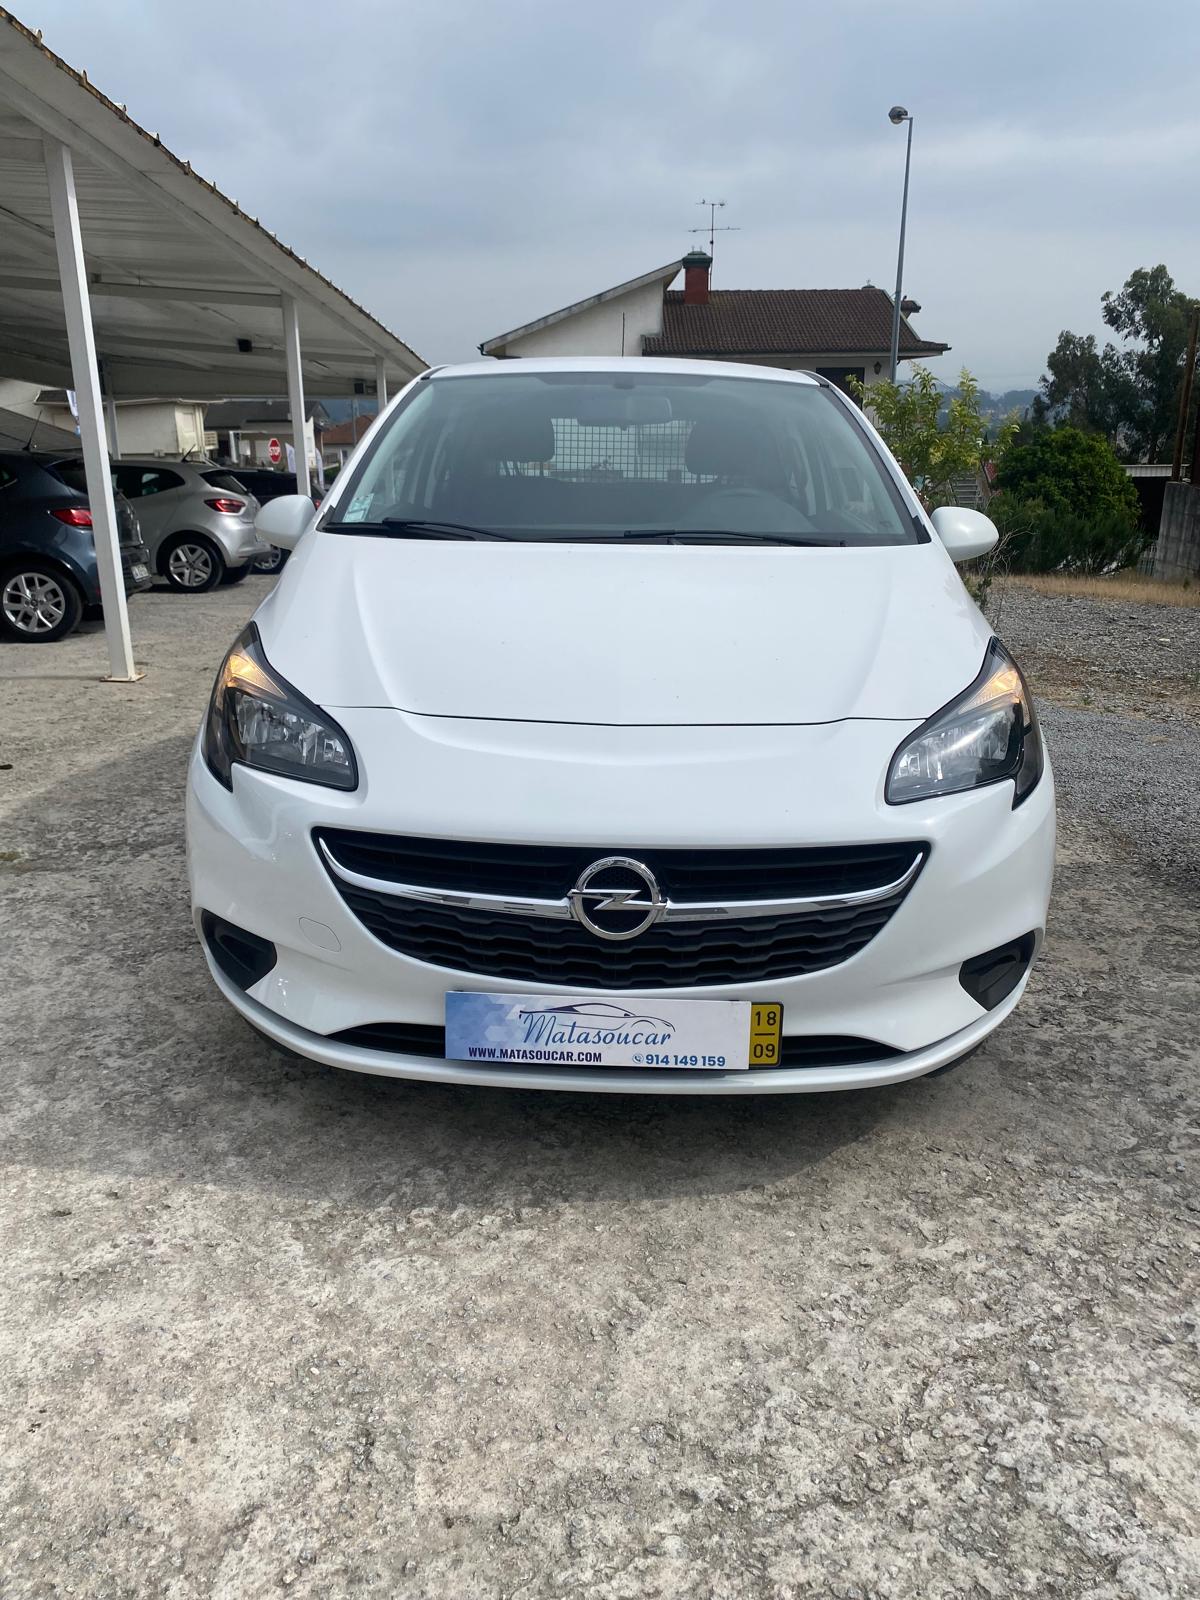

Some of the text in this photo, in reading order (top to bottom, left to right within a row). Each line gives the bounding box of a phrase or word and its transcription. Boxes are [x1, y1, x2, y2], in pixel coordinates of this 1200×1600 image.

[755, 1010, 777, 1026] 18
[523, 1012, 671, 1046] Matasoucar
[468, 1047, 602, 1063] WWW.MATASOUCAR.COM
[753, 1043, 776, 1059] 09
[645, 1054, 726, 1067] 914 149 159
